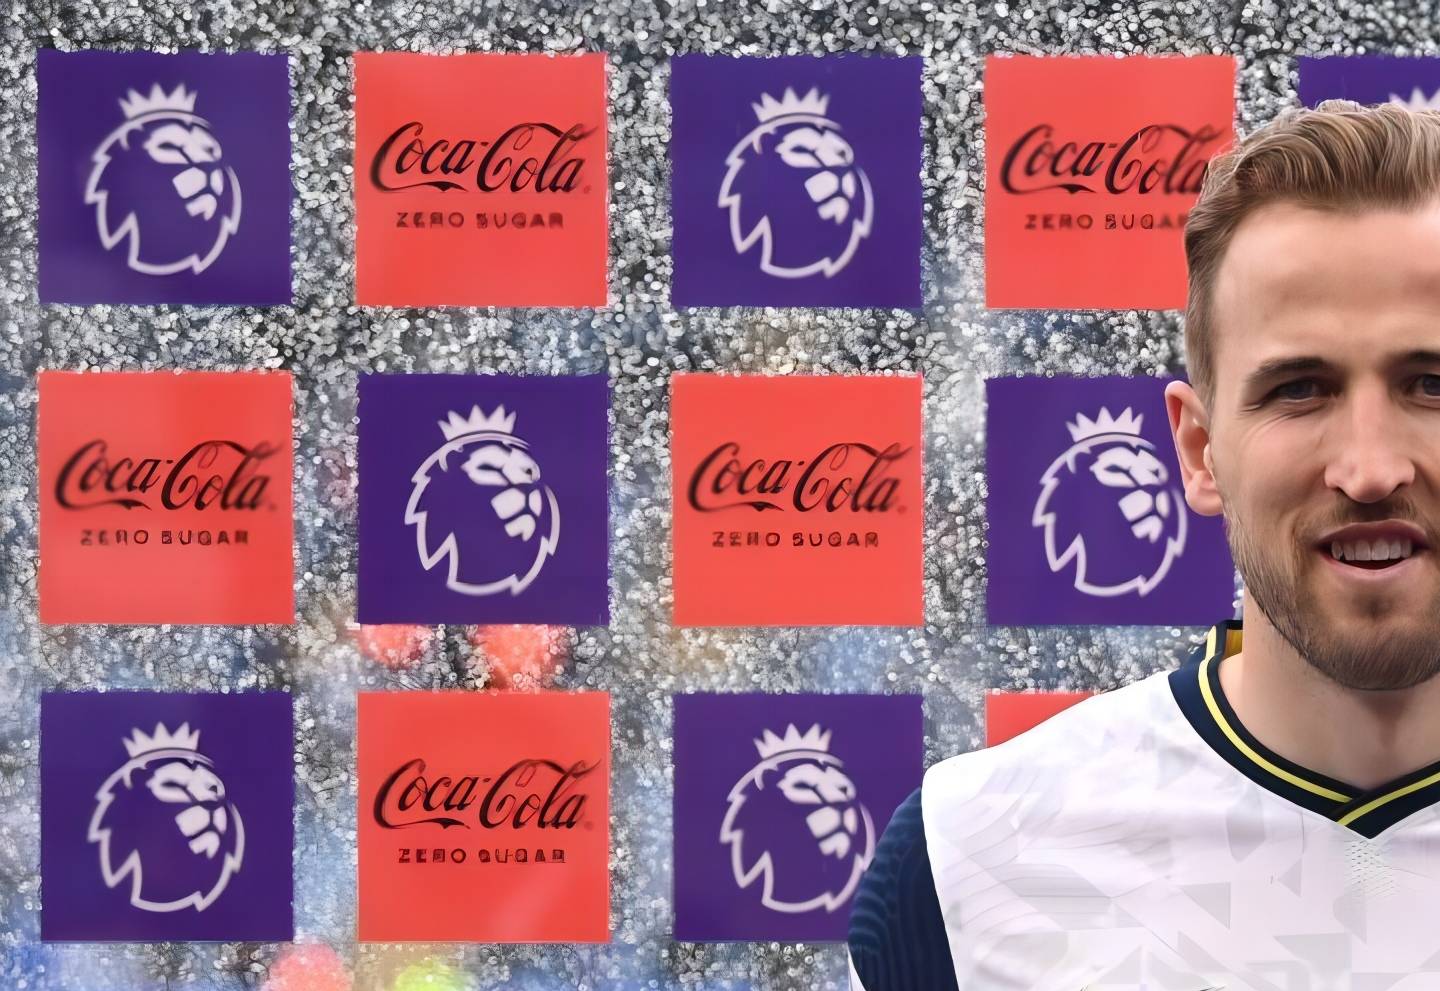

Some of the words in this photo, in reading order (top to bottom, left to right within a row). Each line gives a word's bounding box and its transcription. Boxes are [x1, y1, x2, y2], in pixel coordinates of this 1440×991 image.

[368, 122, 597, 195] Coca-Cola
[397, 212, 466, 230] ZERO
[476, 212, 565, 230] SUGAR
[1026, 214, 1095, 231] ZERO
[53, 440, 282, 513] Coca-Cola
[686, 442, 915, 515] Coca-Cola
[81, 530, 150, 547] ZERO
[162, 530, 250, 547] SUGAR
[713, 532, 782, 549] ZERO
[793, 532, 880, 549] SUGAR
[372, 759, 601, 831] Coca-Cola
[399, 848, 468, 866] ZERO
[479, 848, 567, 866] SUGAR
